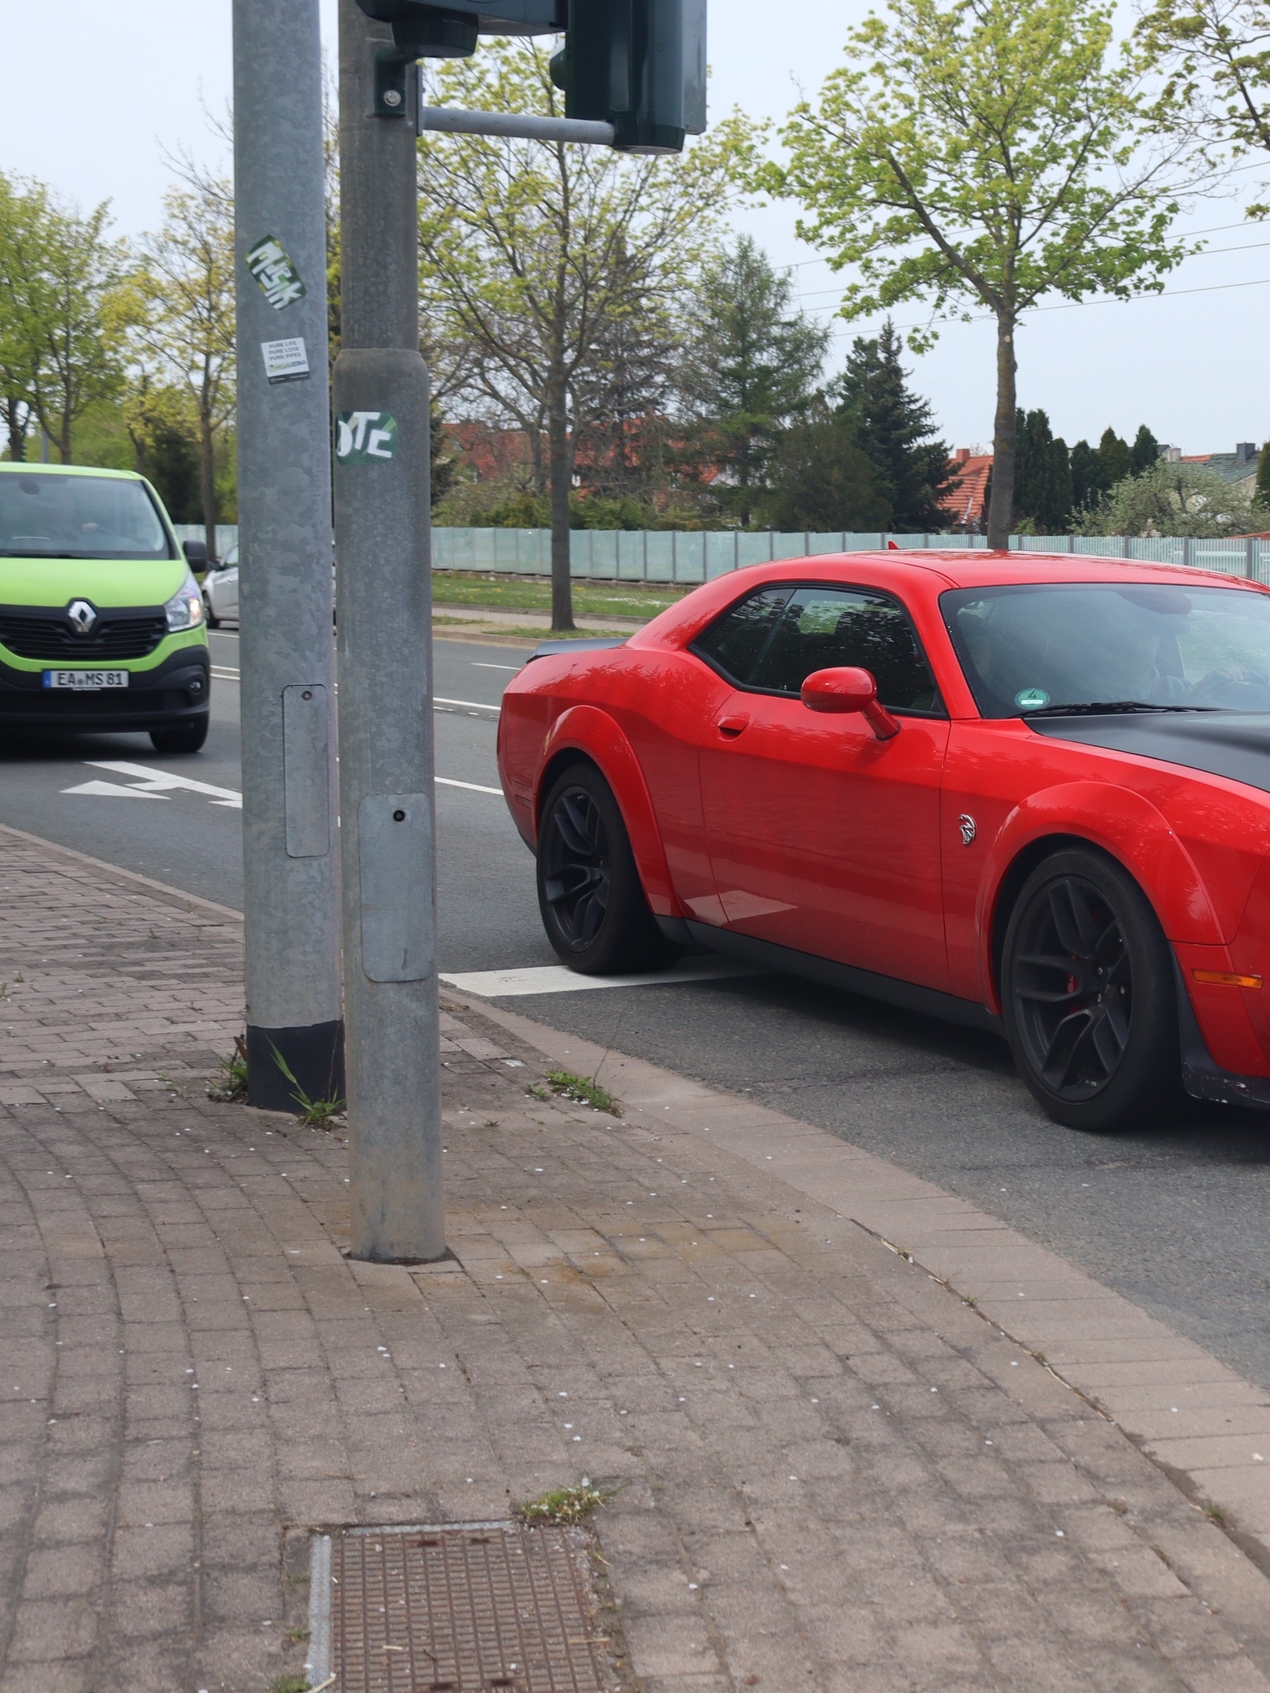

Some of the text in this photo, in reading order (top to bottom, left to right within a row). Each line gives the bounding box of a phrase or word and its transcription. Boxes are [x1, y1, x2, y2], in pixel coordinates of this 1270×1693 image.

[57, 672, 124, 686] EA MS 81
[1027, 690, 1036, 699] 4
